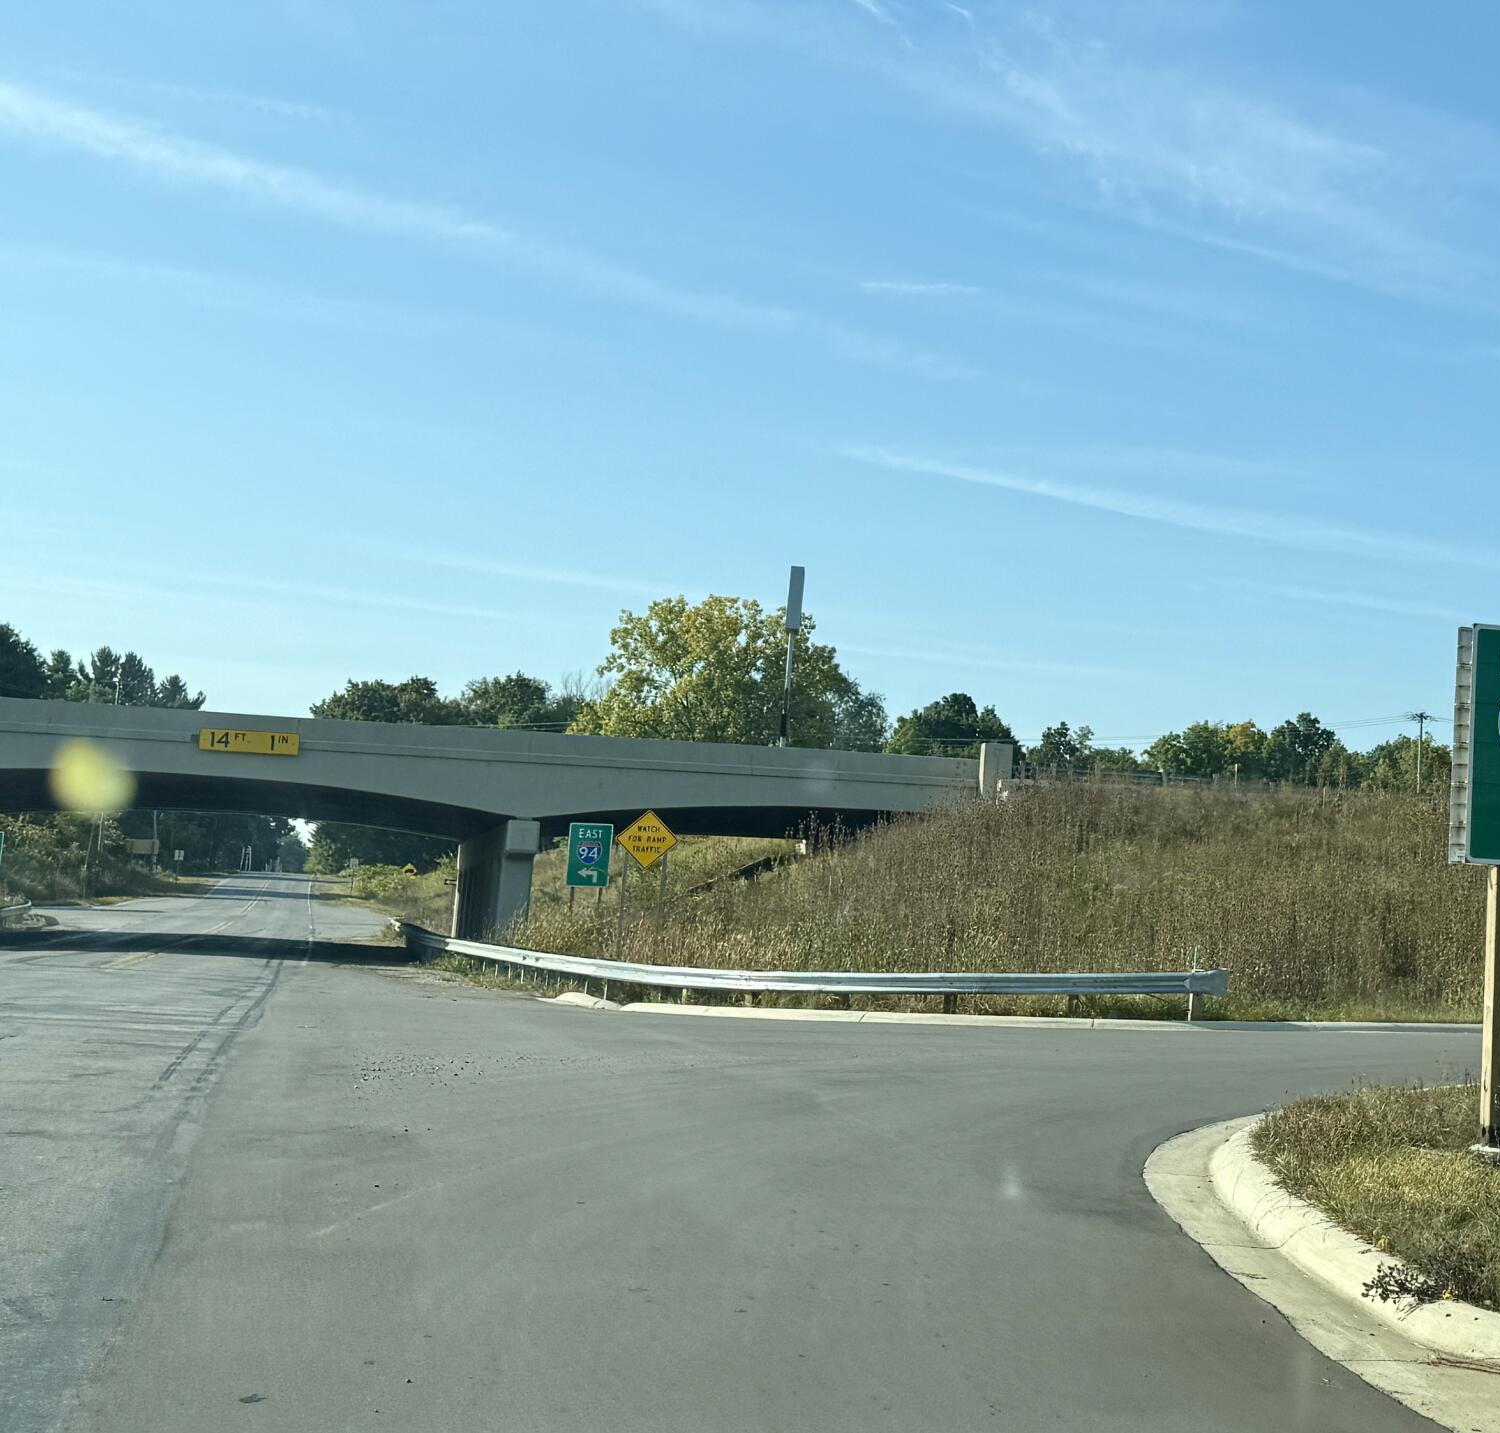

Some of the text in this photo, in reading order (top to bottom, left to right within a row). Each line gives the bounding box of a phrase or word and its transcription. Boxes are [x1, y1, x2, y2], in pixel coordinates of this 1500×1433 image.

[210, 731, 230, 748] 14
[270, 735, 275, 751] 1
[278, 735, 289, 744] IN
[579, 828, 603, 839] EAST
[579, 846, 598, 860] 94
[632, 845, 662, 854] TRAFFIC
